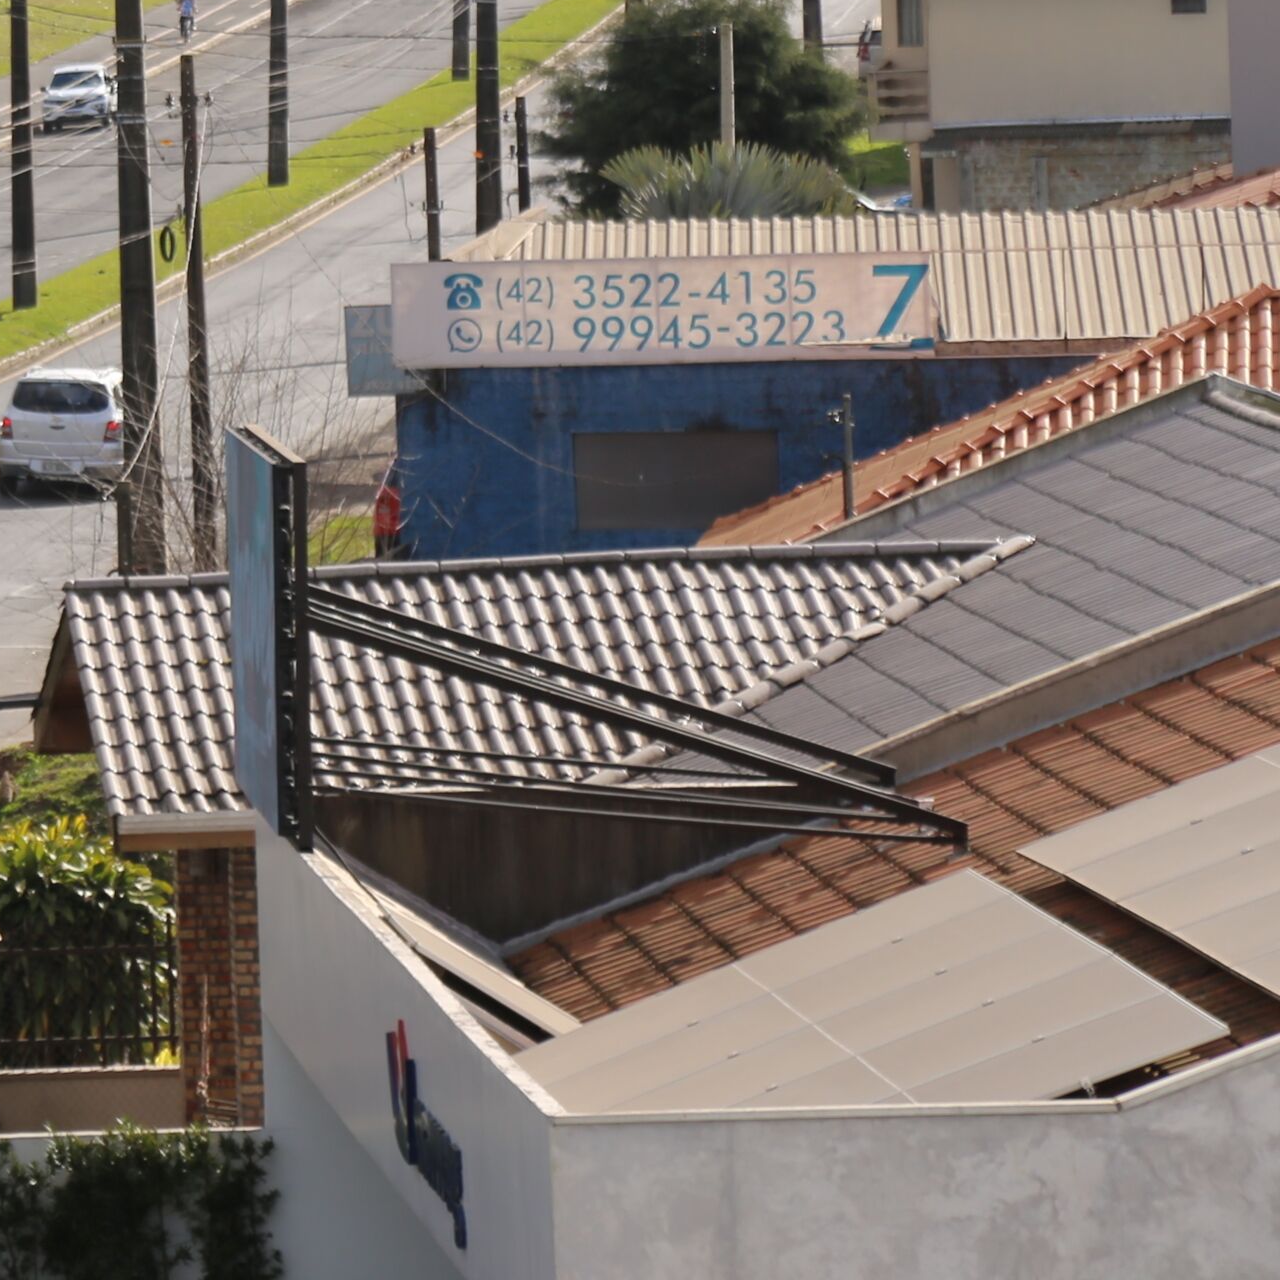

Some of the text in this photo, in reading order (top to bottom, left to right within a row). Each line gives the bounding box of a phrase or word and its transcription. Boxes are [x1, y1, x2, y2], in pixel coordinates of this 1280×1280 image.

[495, 269, 816, 310] (42) 3522-4135
[495, 310, 846, 354] (42) 99945-3223
